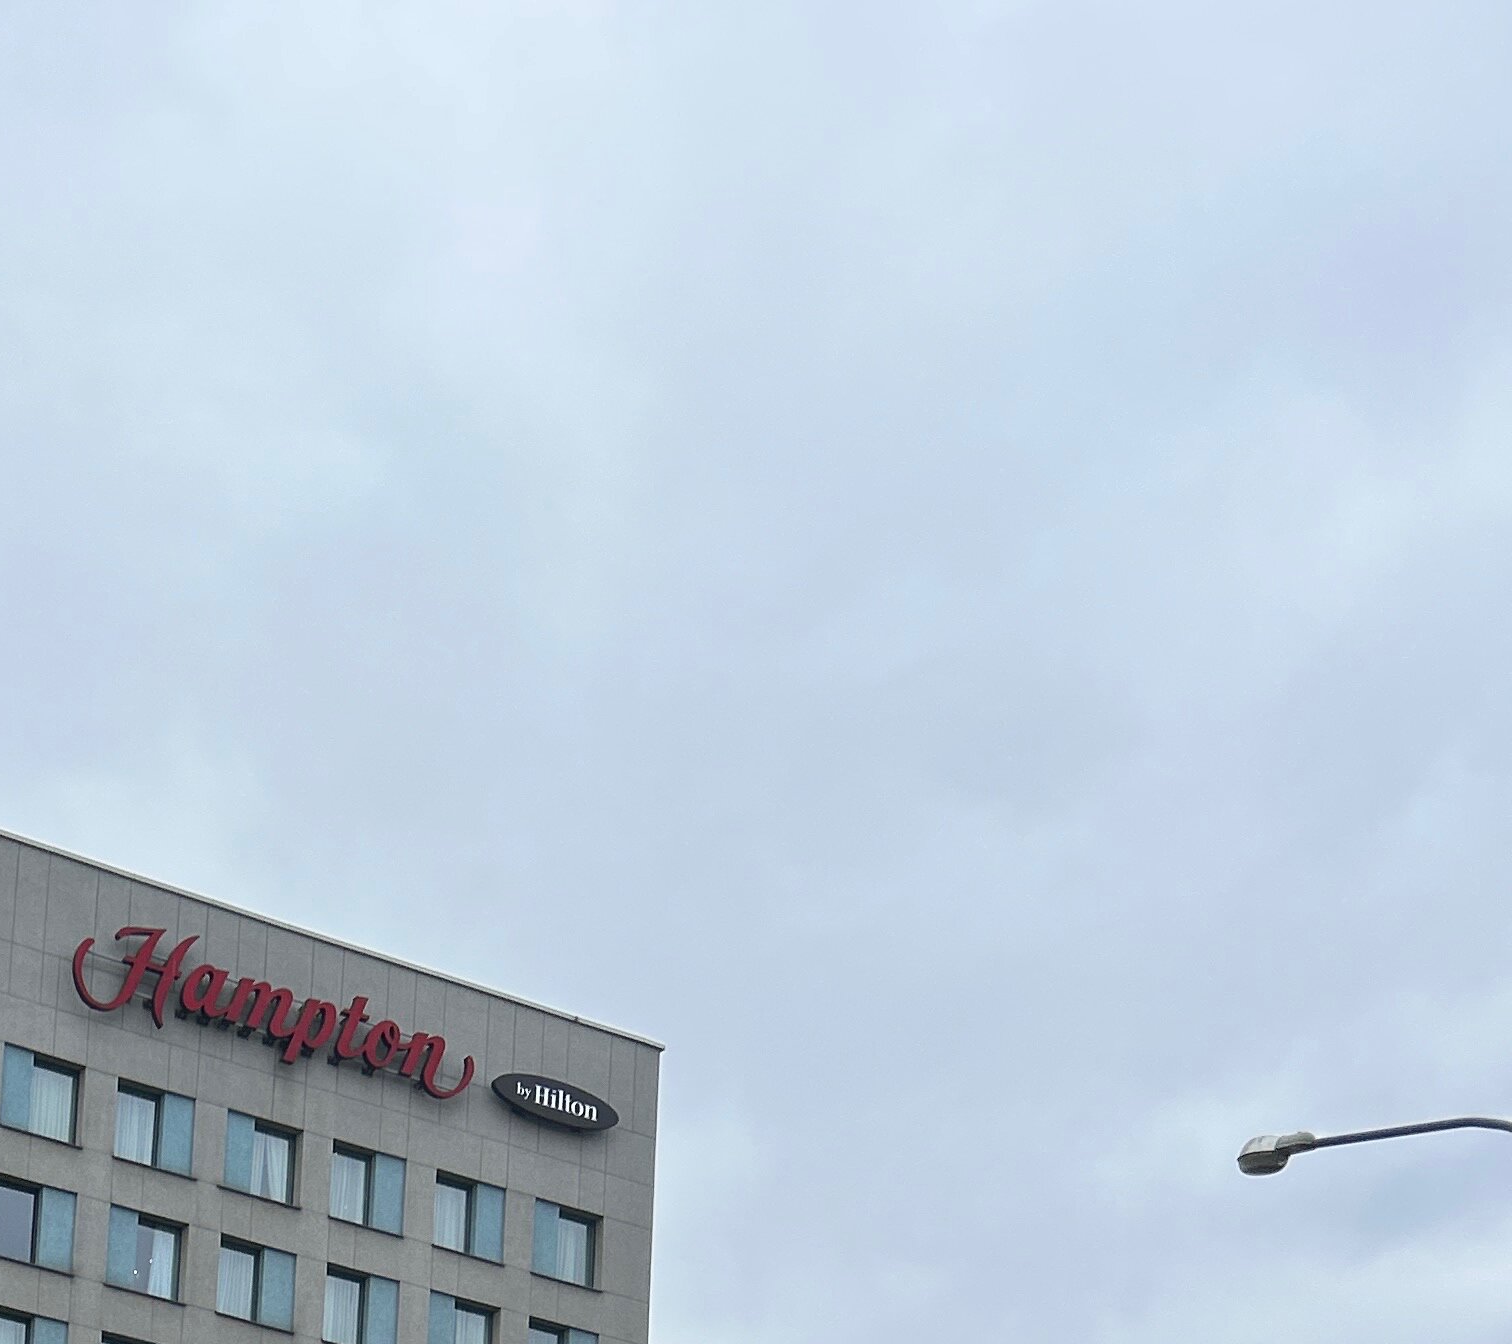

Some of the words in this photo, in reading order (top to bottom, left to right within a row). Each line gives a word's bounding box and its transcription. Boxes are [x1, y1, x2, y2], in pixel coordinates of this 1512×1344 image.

[72, 926, 475, 1099] Hampton
[516, 1081, 531, 1100] by
[534, 1084, 597, 1121] Hilton
